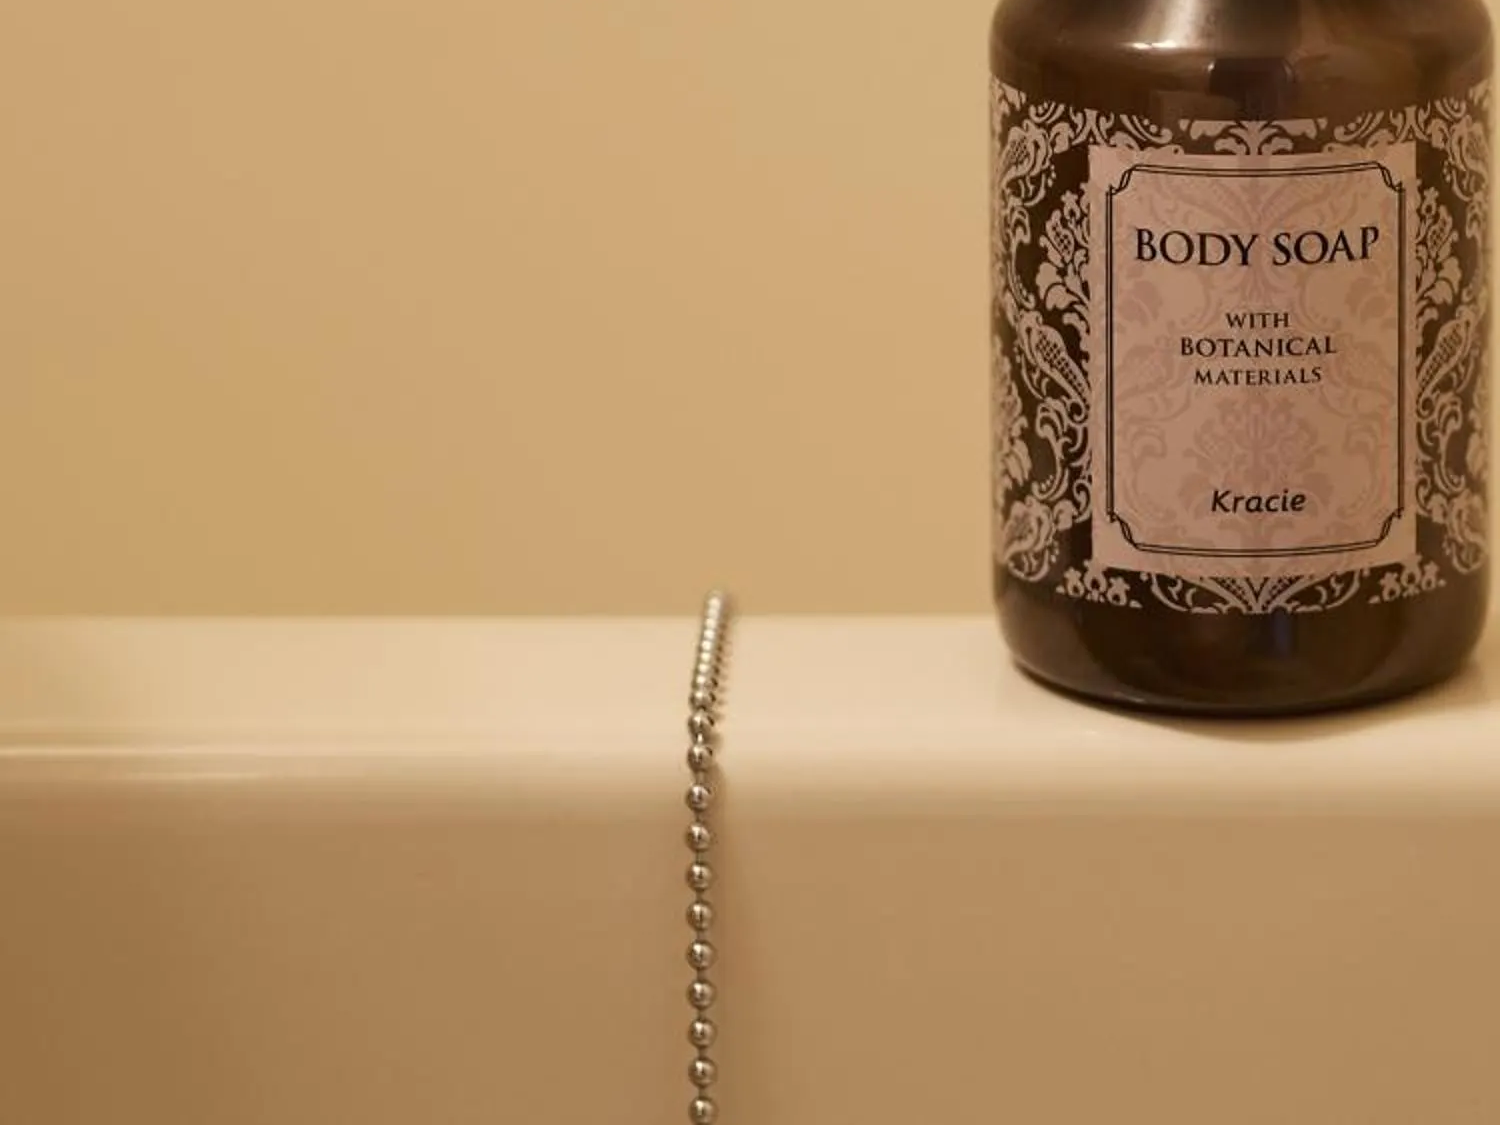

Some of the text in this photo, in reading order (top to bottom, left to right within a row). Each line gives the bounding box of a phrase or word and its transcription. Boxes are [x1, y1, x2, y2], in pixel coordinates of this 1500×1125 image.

[1136, 226, 1380, 267] BODY SOAP
[1226, 312, 1289, 329] WITH
[1181, 335, 1338, 358] BOTANICAL
[1194, 366, 1322, 386] MATERIALS
[1211, 488, 1307, 514] Kracie
